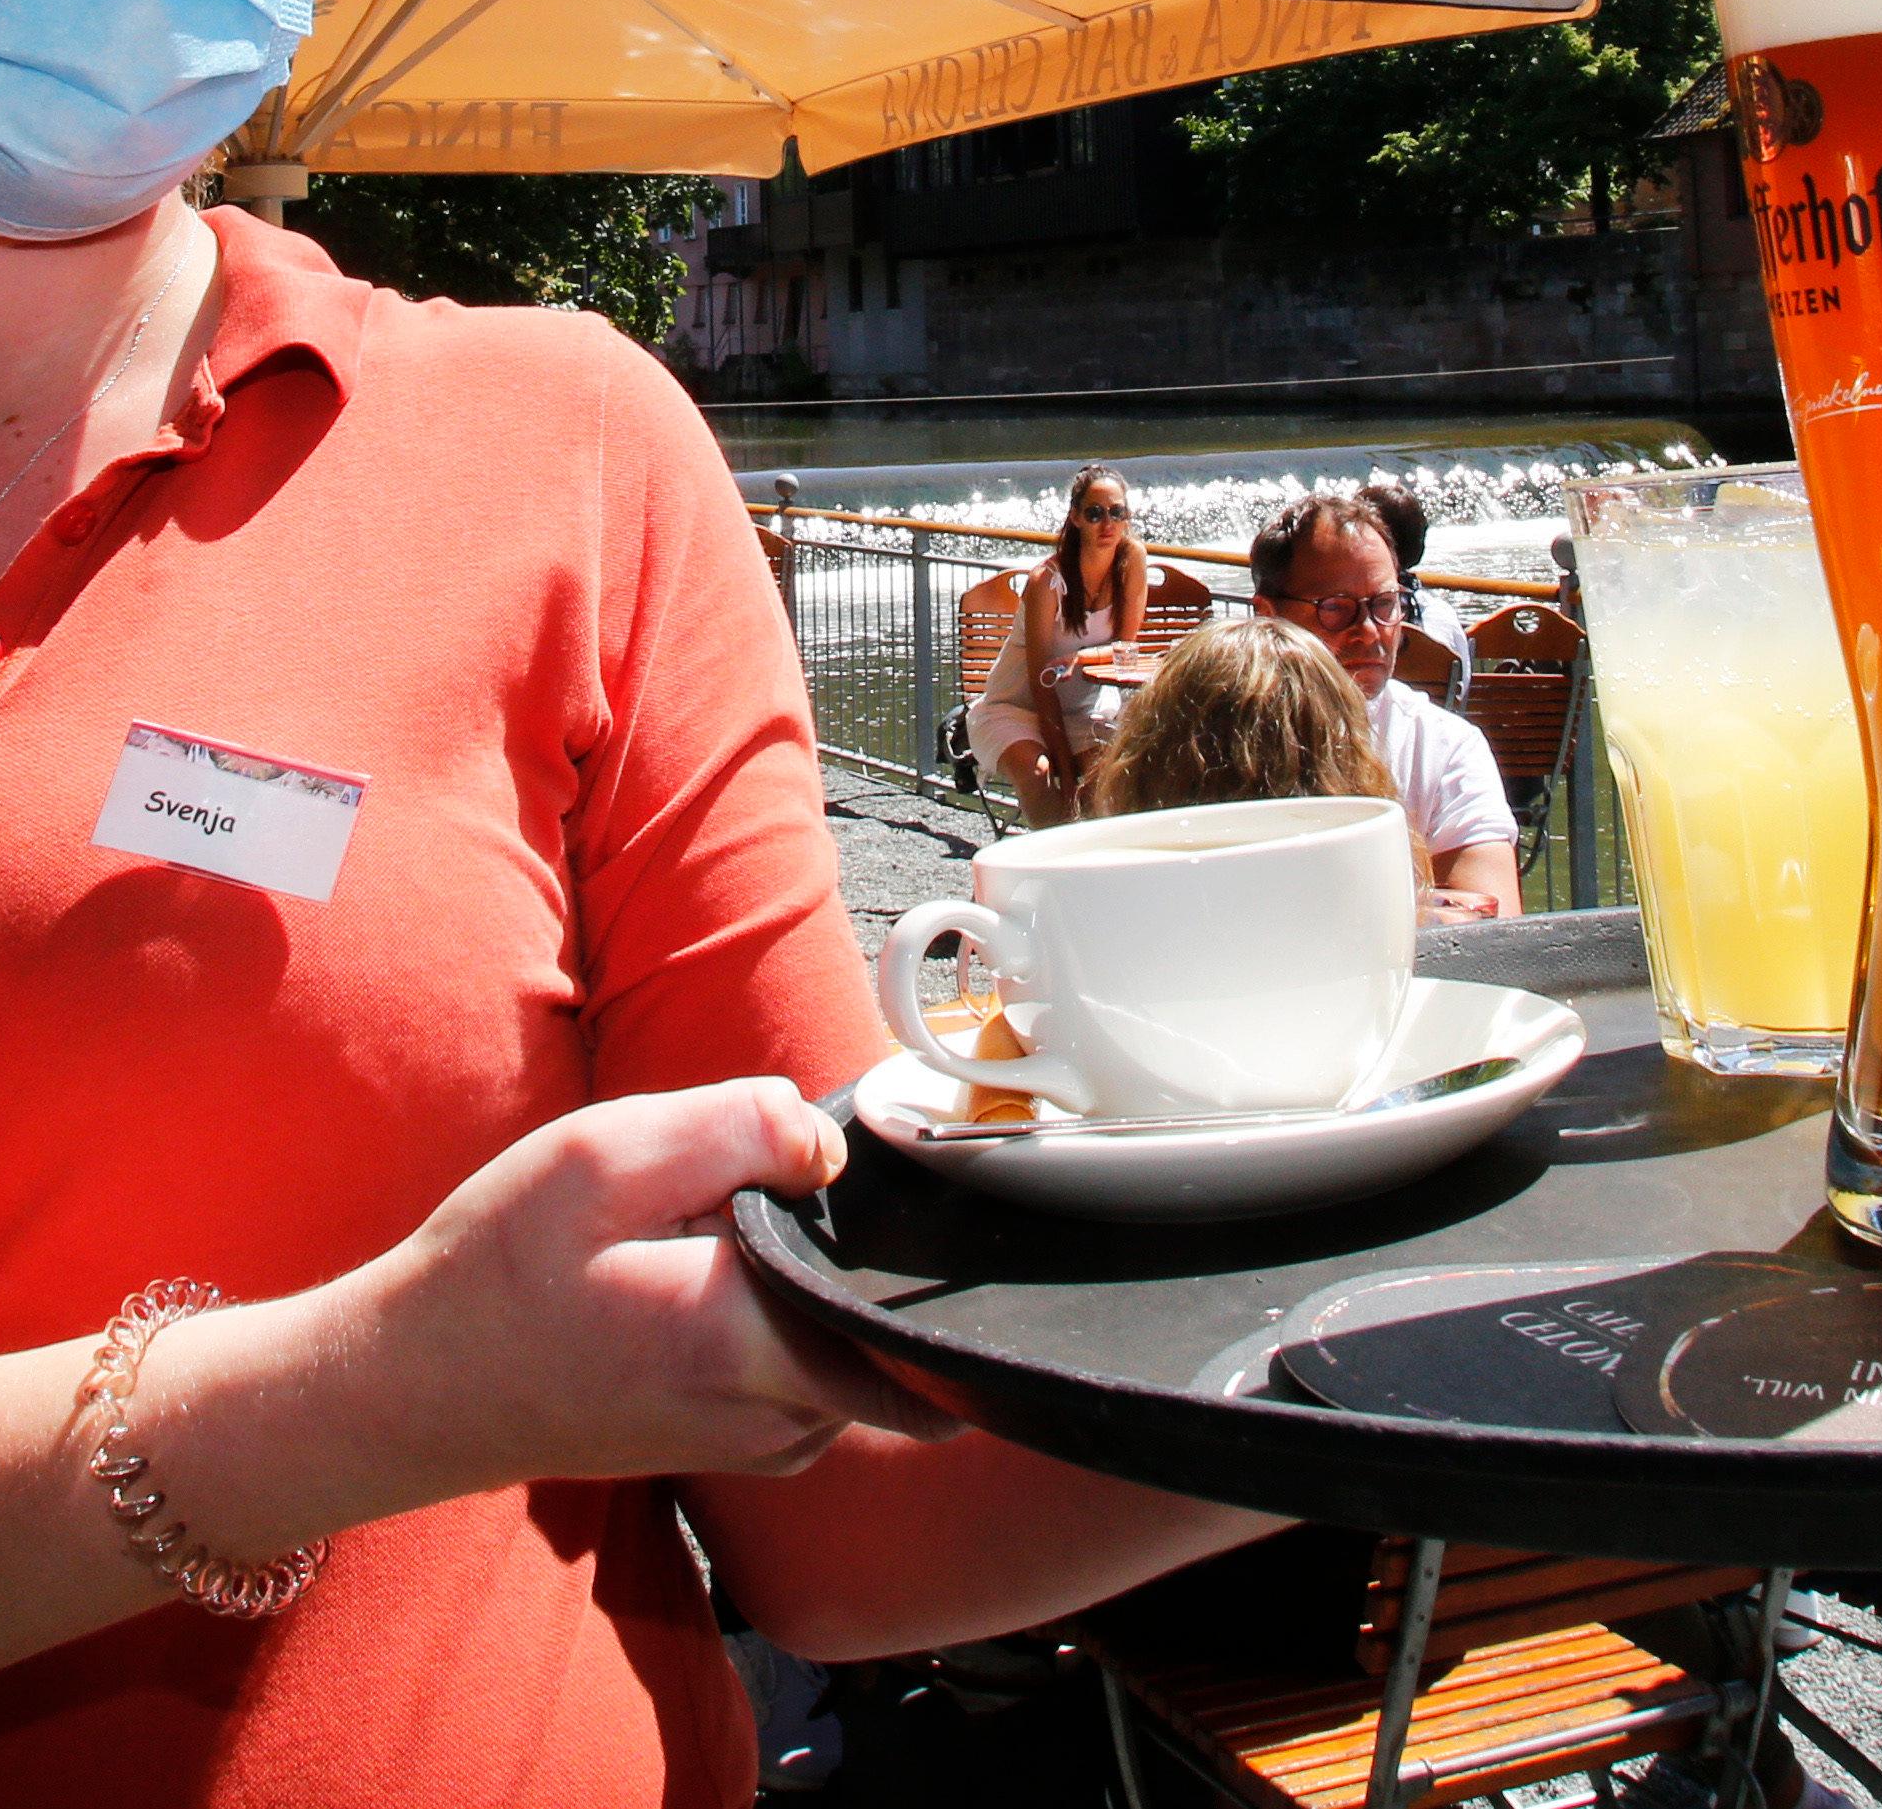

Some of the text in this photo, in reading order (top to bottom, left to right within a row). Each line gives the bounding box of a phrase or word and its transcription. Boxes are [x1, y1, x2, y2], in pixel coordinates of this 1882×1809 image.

[144, 790, 237, 836] Svenja
[1499, 1311, 1623, 1378] CELON
[1742, 1374, 1825, 1401] WILL,
